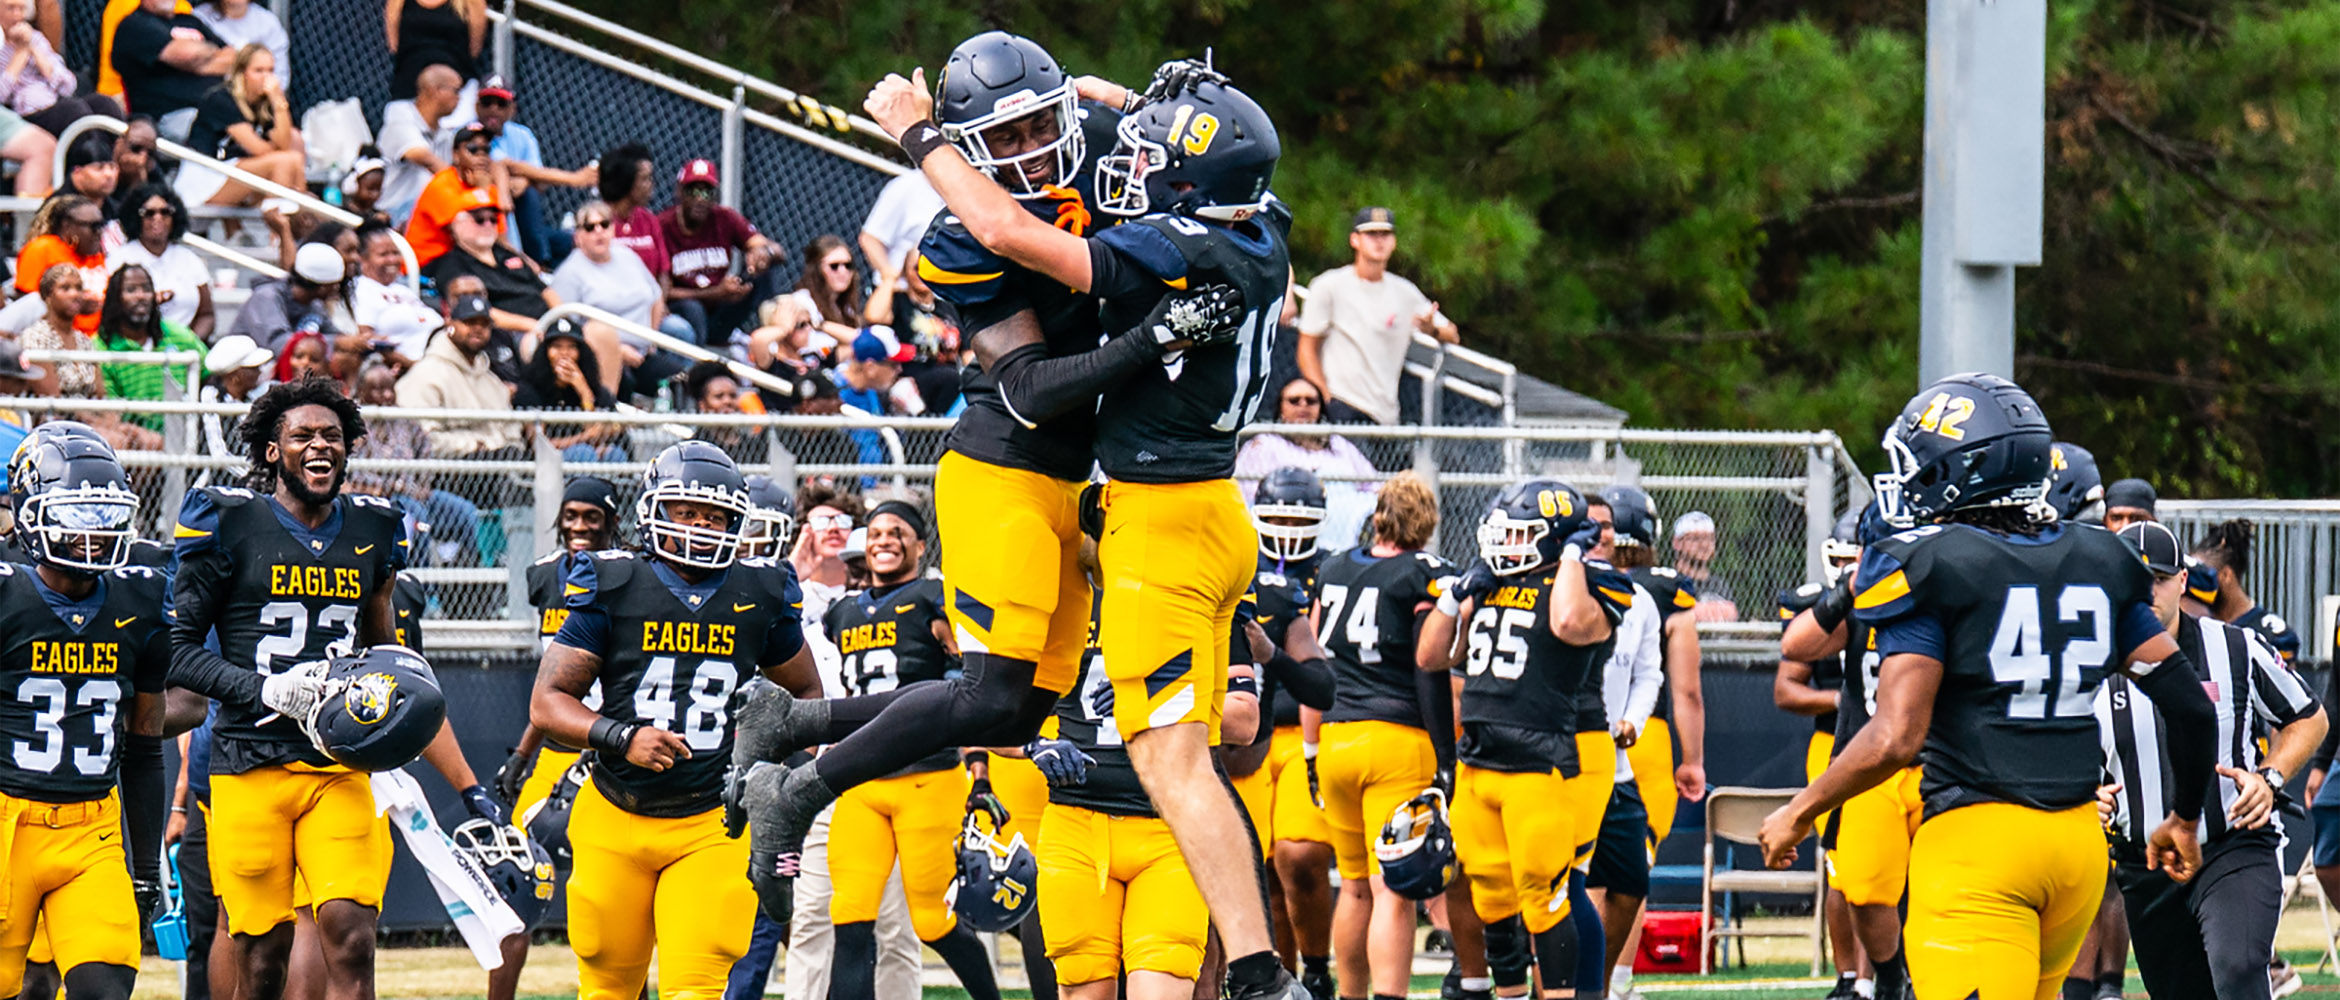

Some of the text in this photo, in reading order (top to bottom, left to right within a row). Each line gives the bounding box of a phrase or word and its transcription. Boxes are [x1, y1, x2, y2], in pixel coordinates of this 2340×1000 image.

[1167, 104, 1220, 156] 19
[1210, 296, 1284, 432] 19
[1920, 392, 1975, 441] 42
[1537, 490, 1573, 517] 65
[271, 565, 361, 599] EAGLES
[642, 621, 736, 655] EAGLES
[840, 621, 896, 655] EAGLES
[1318, 584, 1382, 664] 74
[1466, 608, 1536, 680] 65
[31, 641, 118, 674] EAGLES
[1988, 585, 2111, 718] 42
[634, 656, 738, 750] 48
[2113, 691, 2127, 710] S
[13, 677, 121, 775] 33
